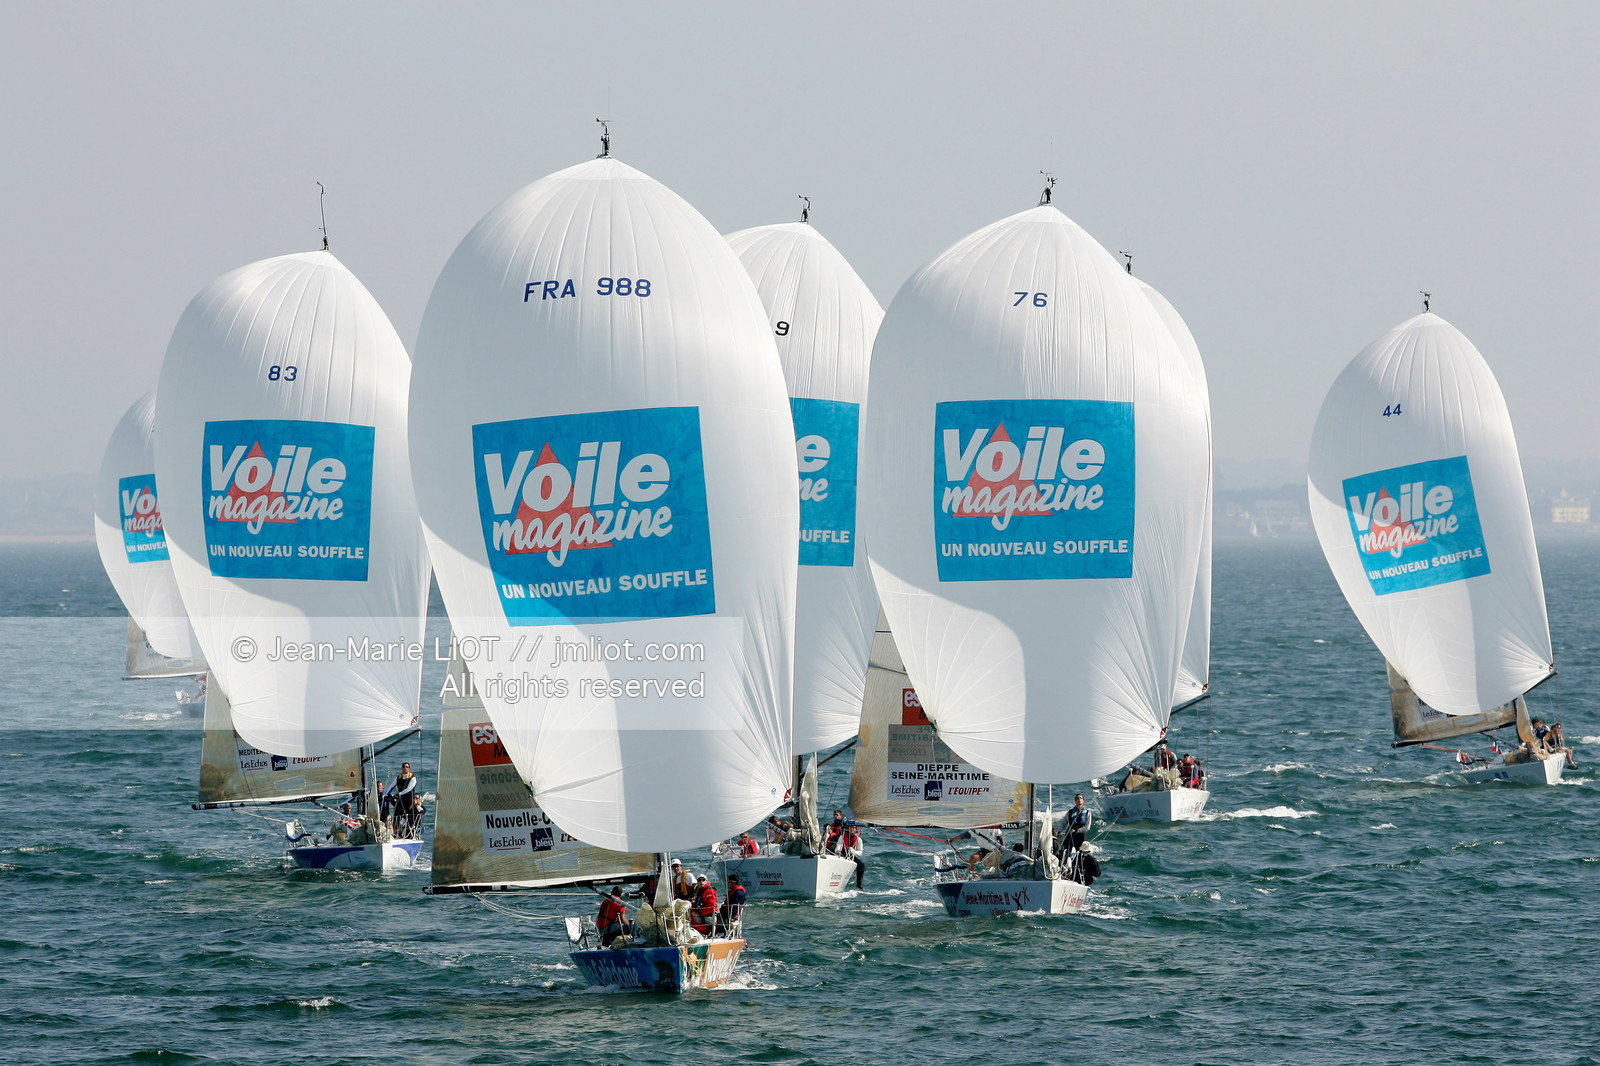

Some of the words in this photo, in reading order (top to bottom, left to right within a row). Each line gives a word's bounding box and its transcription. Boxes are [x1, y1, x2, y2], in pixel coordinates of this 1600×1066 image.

[523, 279, 576, 302] FRA
[596, 277, 651, 297] 988
[1012, 291, 1048, 307] 76
[268, 365, 297, 381] 83
[1382, 403, 1402, 417] 44
[210, 444, 346, 494] Voile
[943, 426, 1106, 482] Voile
[483, 440, 670, 515] Voile
[208, 491, 343, 535] magazine
[941, 477, 1104, 531] magazine
[1349, 482, 1454, 531] Voile
[493, 501, 673, 567] magazine
[799, 529, 850, 543] UFFLE
[941, 543, 963, 557] UN
[968, 541, 1047, 556] NOUVEAU
[1052, 539, 1129, 554] SOUFFLE
[1359, 514, 1459, 558] magazine
[210, 545, 226, 557] UN
[229, 545, 292, 557] NOUVEAU
[298, 546, 364, 559] SOUFFLE
[1369, 570, 1382, 580] UN
[1382, 559, 1429, 578] NOUVEAU
[1431, 547, 1483, 567] SOUFFLE
[501, 583, 526, 599] UN
[528, 577, 612, 598] NOUVEAU
[618, 569, 708, 591] SOUFFLE
[891, 772, 989, 781] SEINE-MARITIME
[917, 764, 959, 772] DIEPPE
